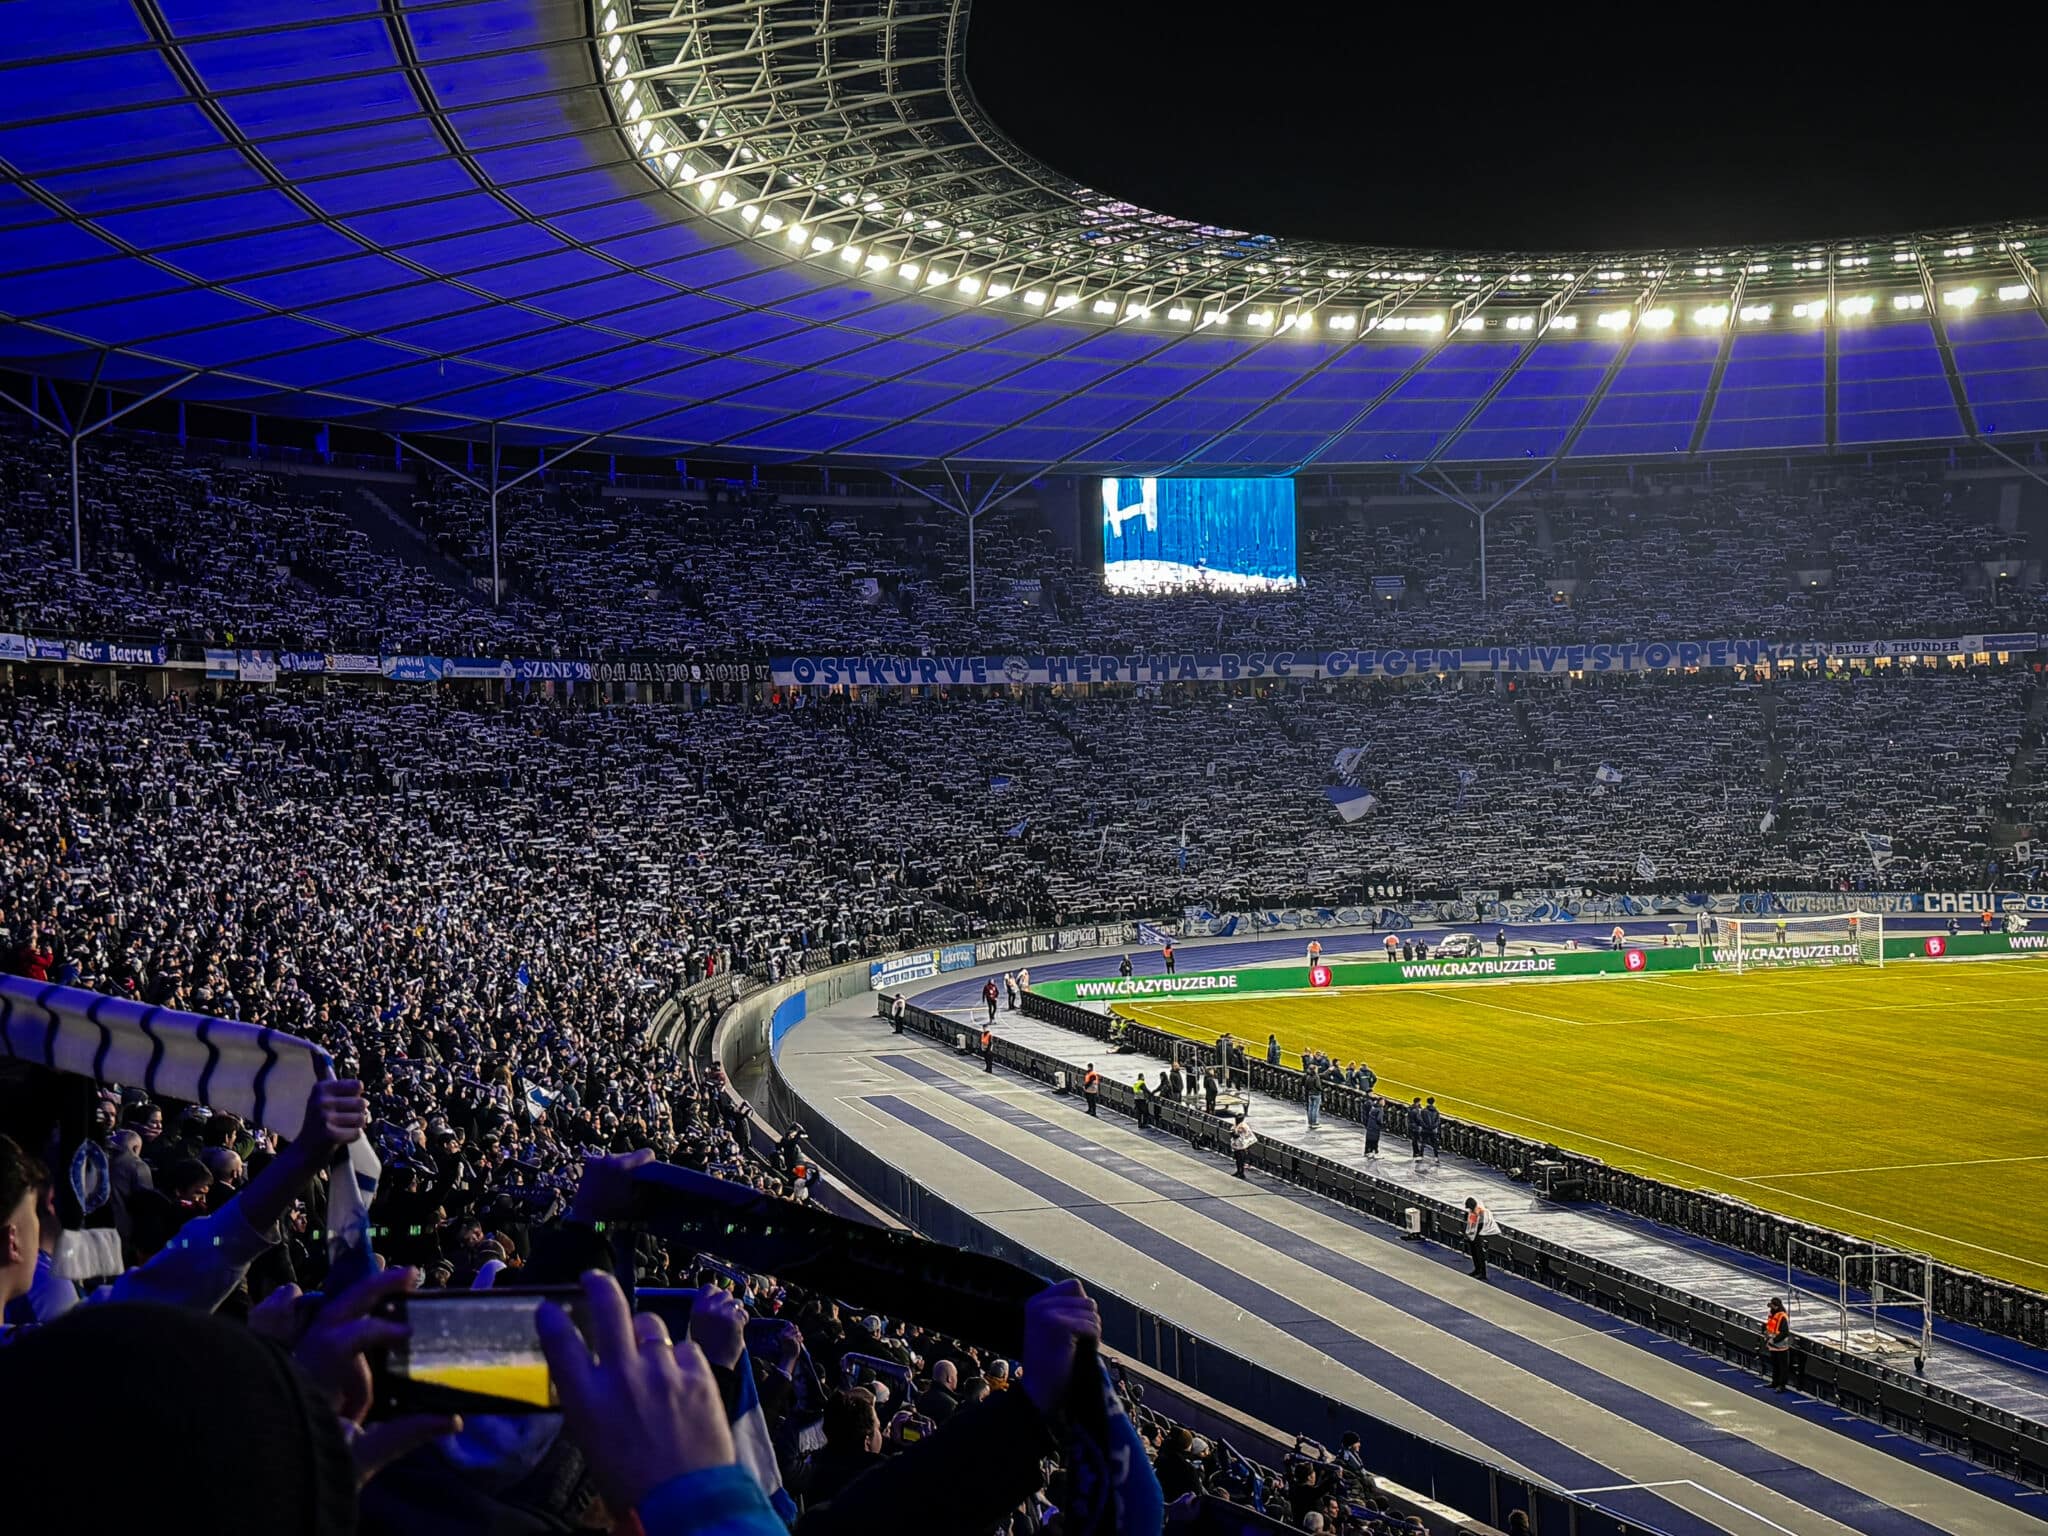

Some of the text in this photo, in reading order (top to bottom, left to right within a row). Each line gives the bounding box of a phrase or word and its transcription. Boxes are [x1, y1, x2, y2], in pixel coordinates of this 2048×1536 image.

[109, 644, 153, 664] Baeren
[1835, 640, 1960, 656] BLUE THUNDER
[791, 656, 987, 684] OSTKURVE
[1045, 654, 1200, 682] HERTHA
[1219, 651, 1296, 680] BSC
[1324, 648, 1463, 677] GEGEN
[1488, 639, 1760, 672] INVESTOREN
[591, 662, 689, 682] COMMANDO
[703, 662, 750, 682] NORD
[1924, 892, 1995, 913] CREW
[976, 938, 1028, 961] HAUPTSTADT
[1031, 933, 1056, 953] KULT
[1712, 943, 1859, 963] WWW.CRAZYBUZZER.DE
[1929, 939, 1940, 954] B
[1402, 959, 1556, 978] WWW.CRAZYBUZZER.DE
[1629, 952, 1641, 968] B
[1076, 975, 1237, 996] WWW.CRAZYBUZZER.DE
[1313, 969, 1326, 985] B
